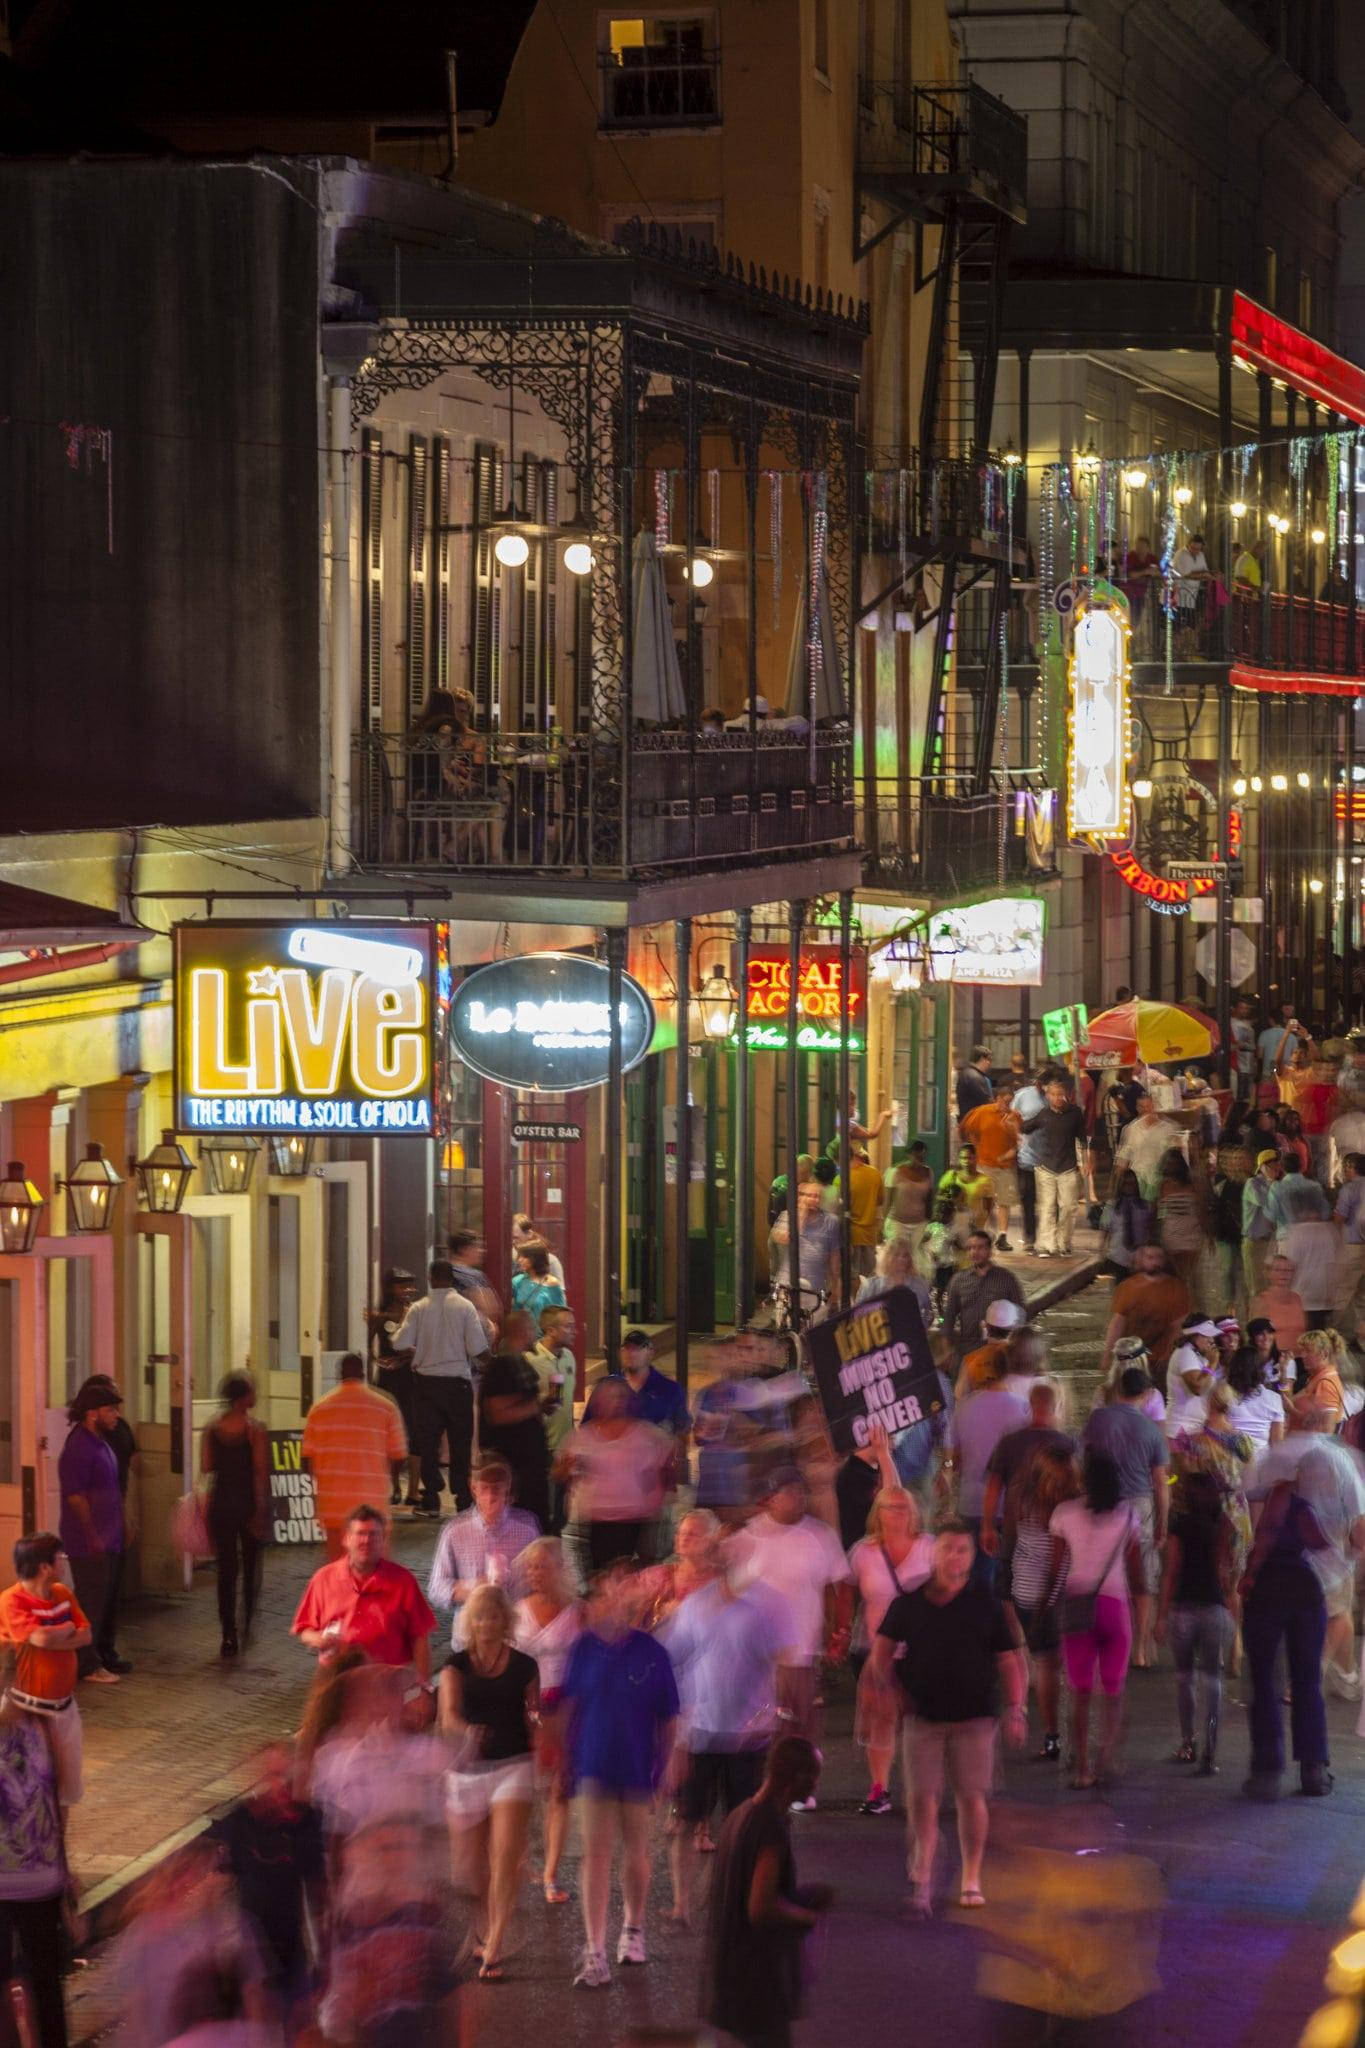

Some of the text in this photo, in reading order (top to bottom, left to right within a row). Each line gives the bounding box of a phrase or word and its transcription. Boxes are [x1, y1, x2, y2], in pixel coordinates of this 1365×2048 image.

[1144, 898, 1193, 915] SEAFOO
[737, 991, 860, 1016] ACORY
[190, 1099, 430, 1127] THE RHYTHM & SOUL OF NOLA
[513, 1126, 580, 1138] OYSTER BAR
[838, 1342, 912, 1397] MUSIC
[863, 1378, 897, 1413] NO
[852, 1396, 923, 1448] COVER
[270, 1474, 319, 1497] MUSI
[288, 1496, 315, 1519] NO
[273, 1518, 327, 1543] COVE
